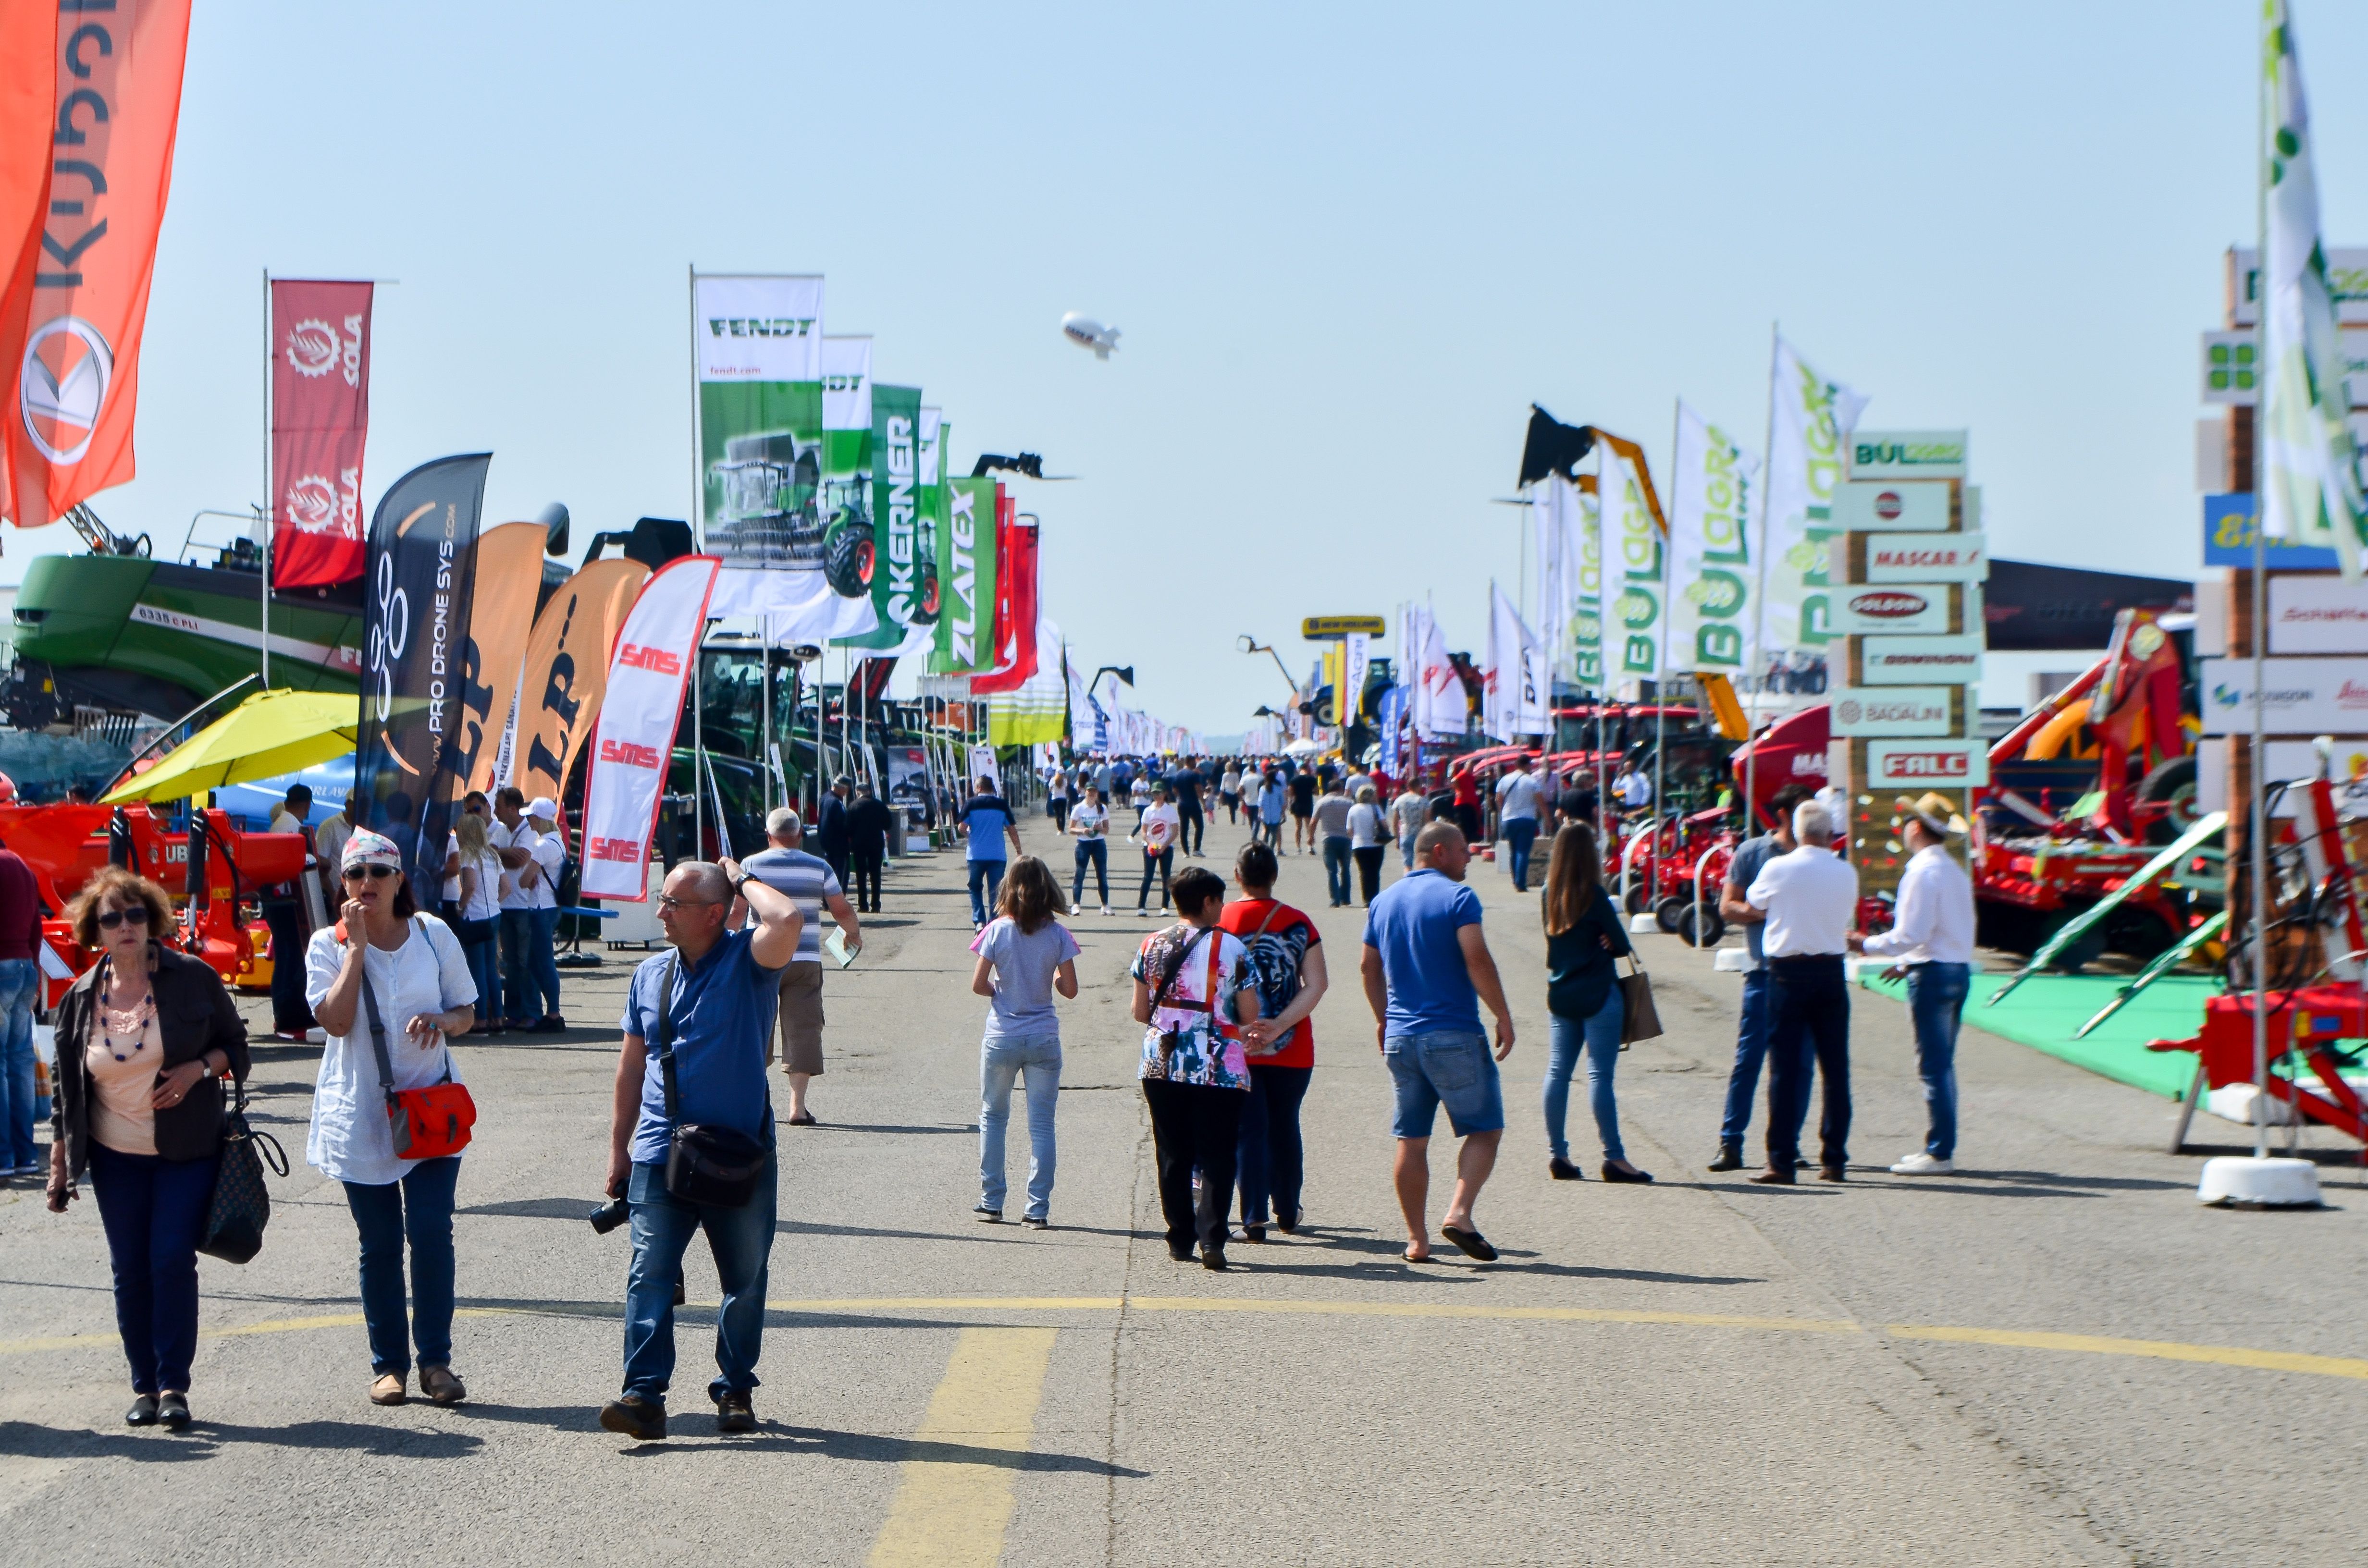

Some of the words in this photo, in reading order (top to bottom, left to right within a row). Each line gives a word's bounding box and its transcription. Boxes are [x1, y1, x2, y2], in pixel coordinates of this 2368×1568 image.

[35, 0, 116, 289] Kubo
[342, 313, 362, 388] SOLA
[709, 318, 816, 337] FENDT
[710, 366, 761, 376] fendt.com
[340, 467, 359, 542] SOLA
[887, 416, 915, 591] KERNER
[950, 484, 975, 667] ZLATEX
[431, 594, 449, 674] DRONE
[620, 644, 680, 675] SMS
[602, 740, 659, 769] SMS
[1885, 754, 1967, 775] FALC
[591, 836, 640, 863] SMS
